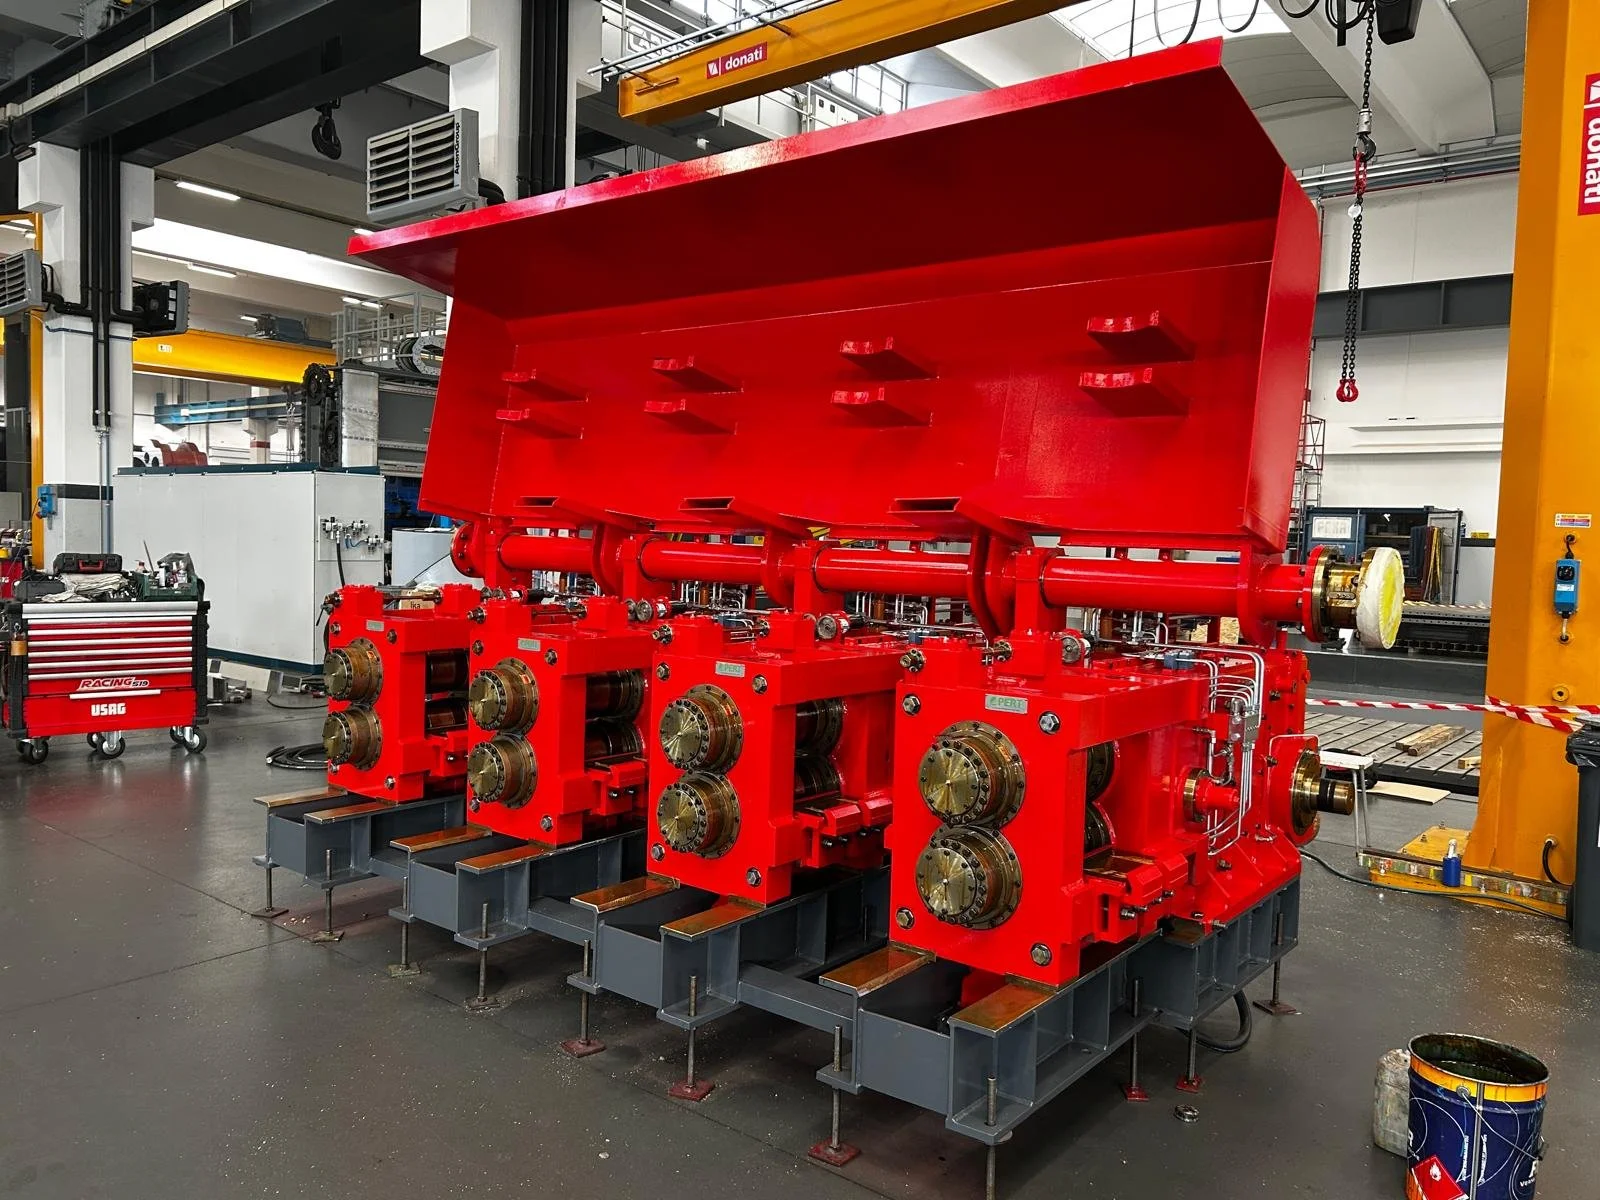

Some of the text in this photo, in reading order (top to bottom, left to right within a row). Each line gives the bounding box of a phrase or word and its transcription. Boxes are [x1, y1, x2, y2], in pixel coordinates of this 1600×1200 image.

[725, 46, 763, 70] donati
[80, 677, 133, 688] RACING
[91, 702, 127, 717] USAG
